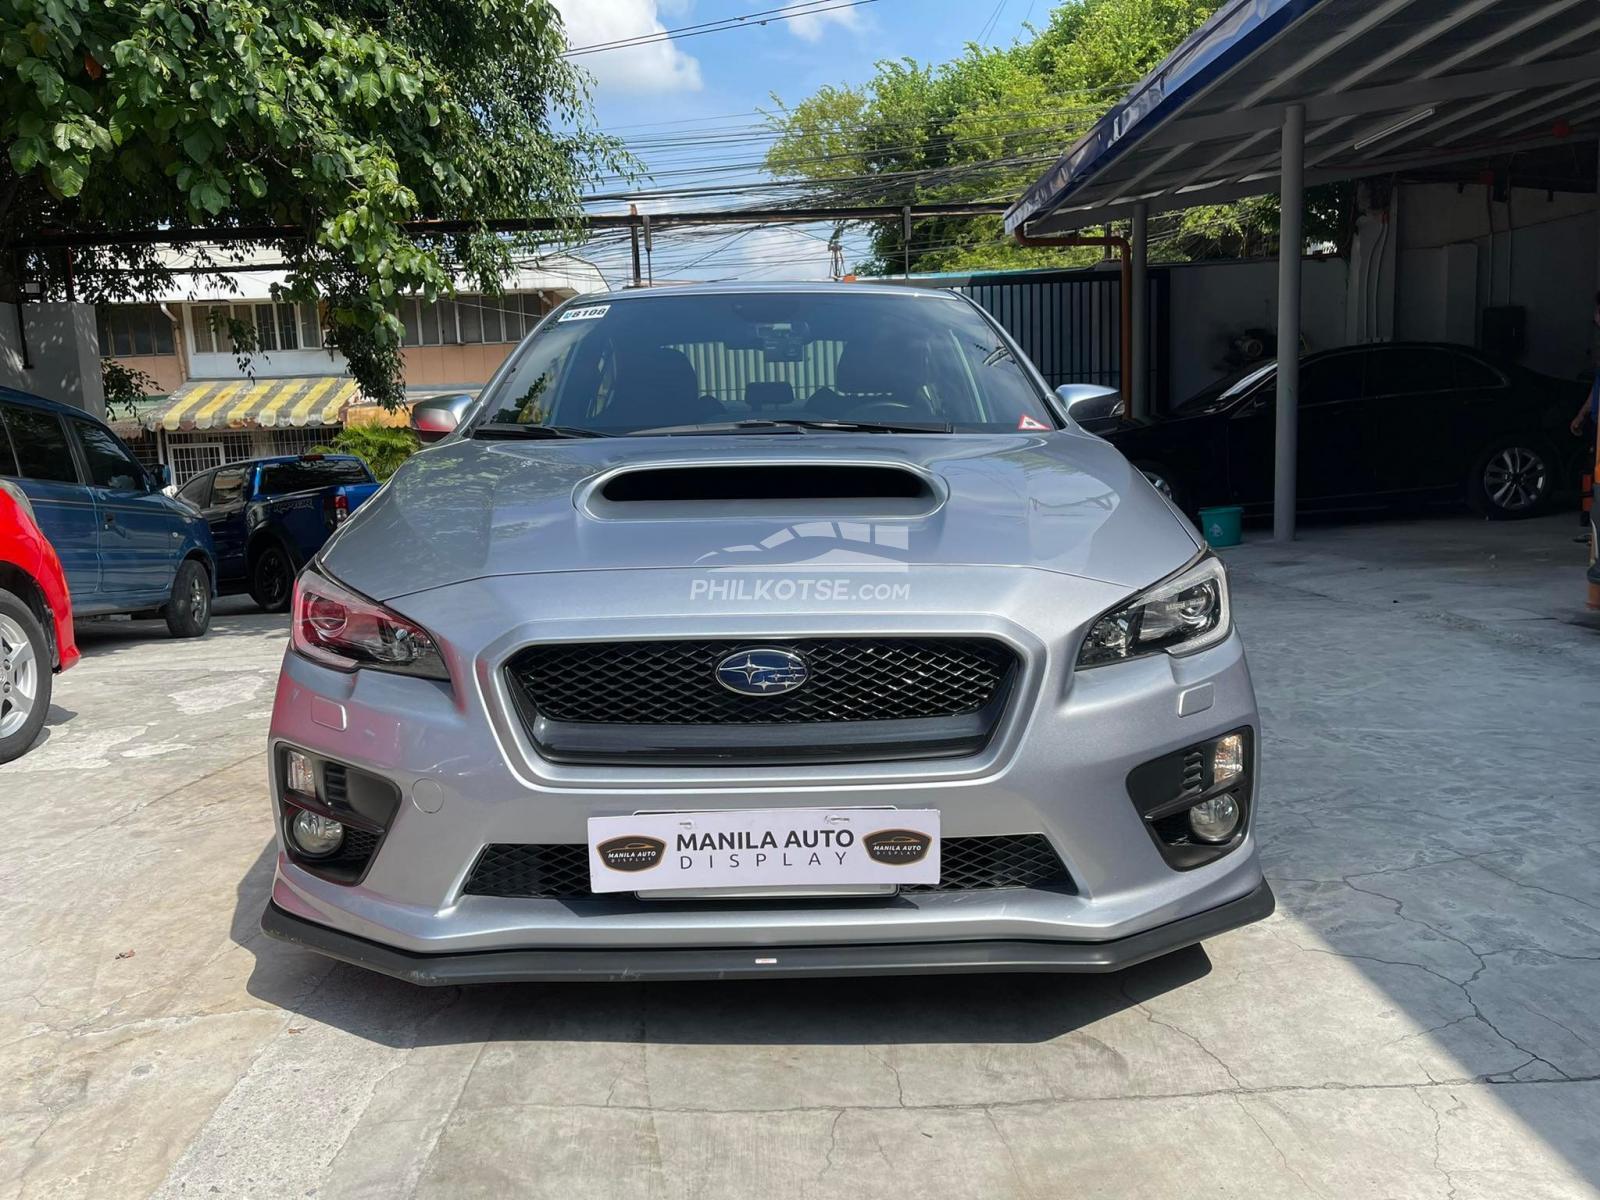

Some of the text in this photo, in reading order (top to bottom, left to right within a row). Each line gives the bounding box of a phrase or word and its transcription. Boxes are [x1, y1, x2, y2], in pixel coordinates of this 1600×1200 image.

[677, 829, 855, 851] MANILA AUTO
[680, 852, 847, 869] DISPLAY
